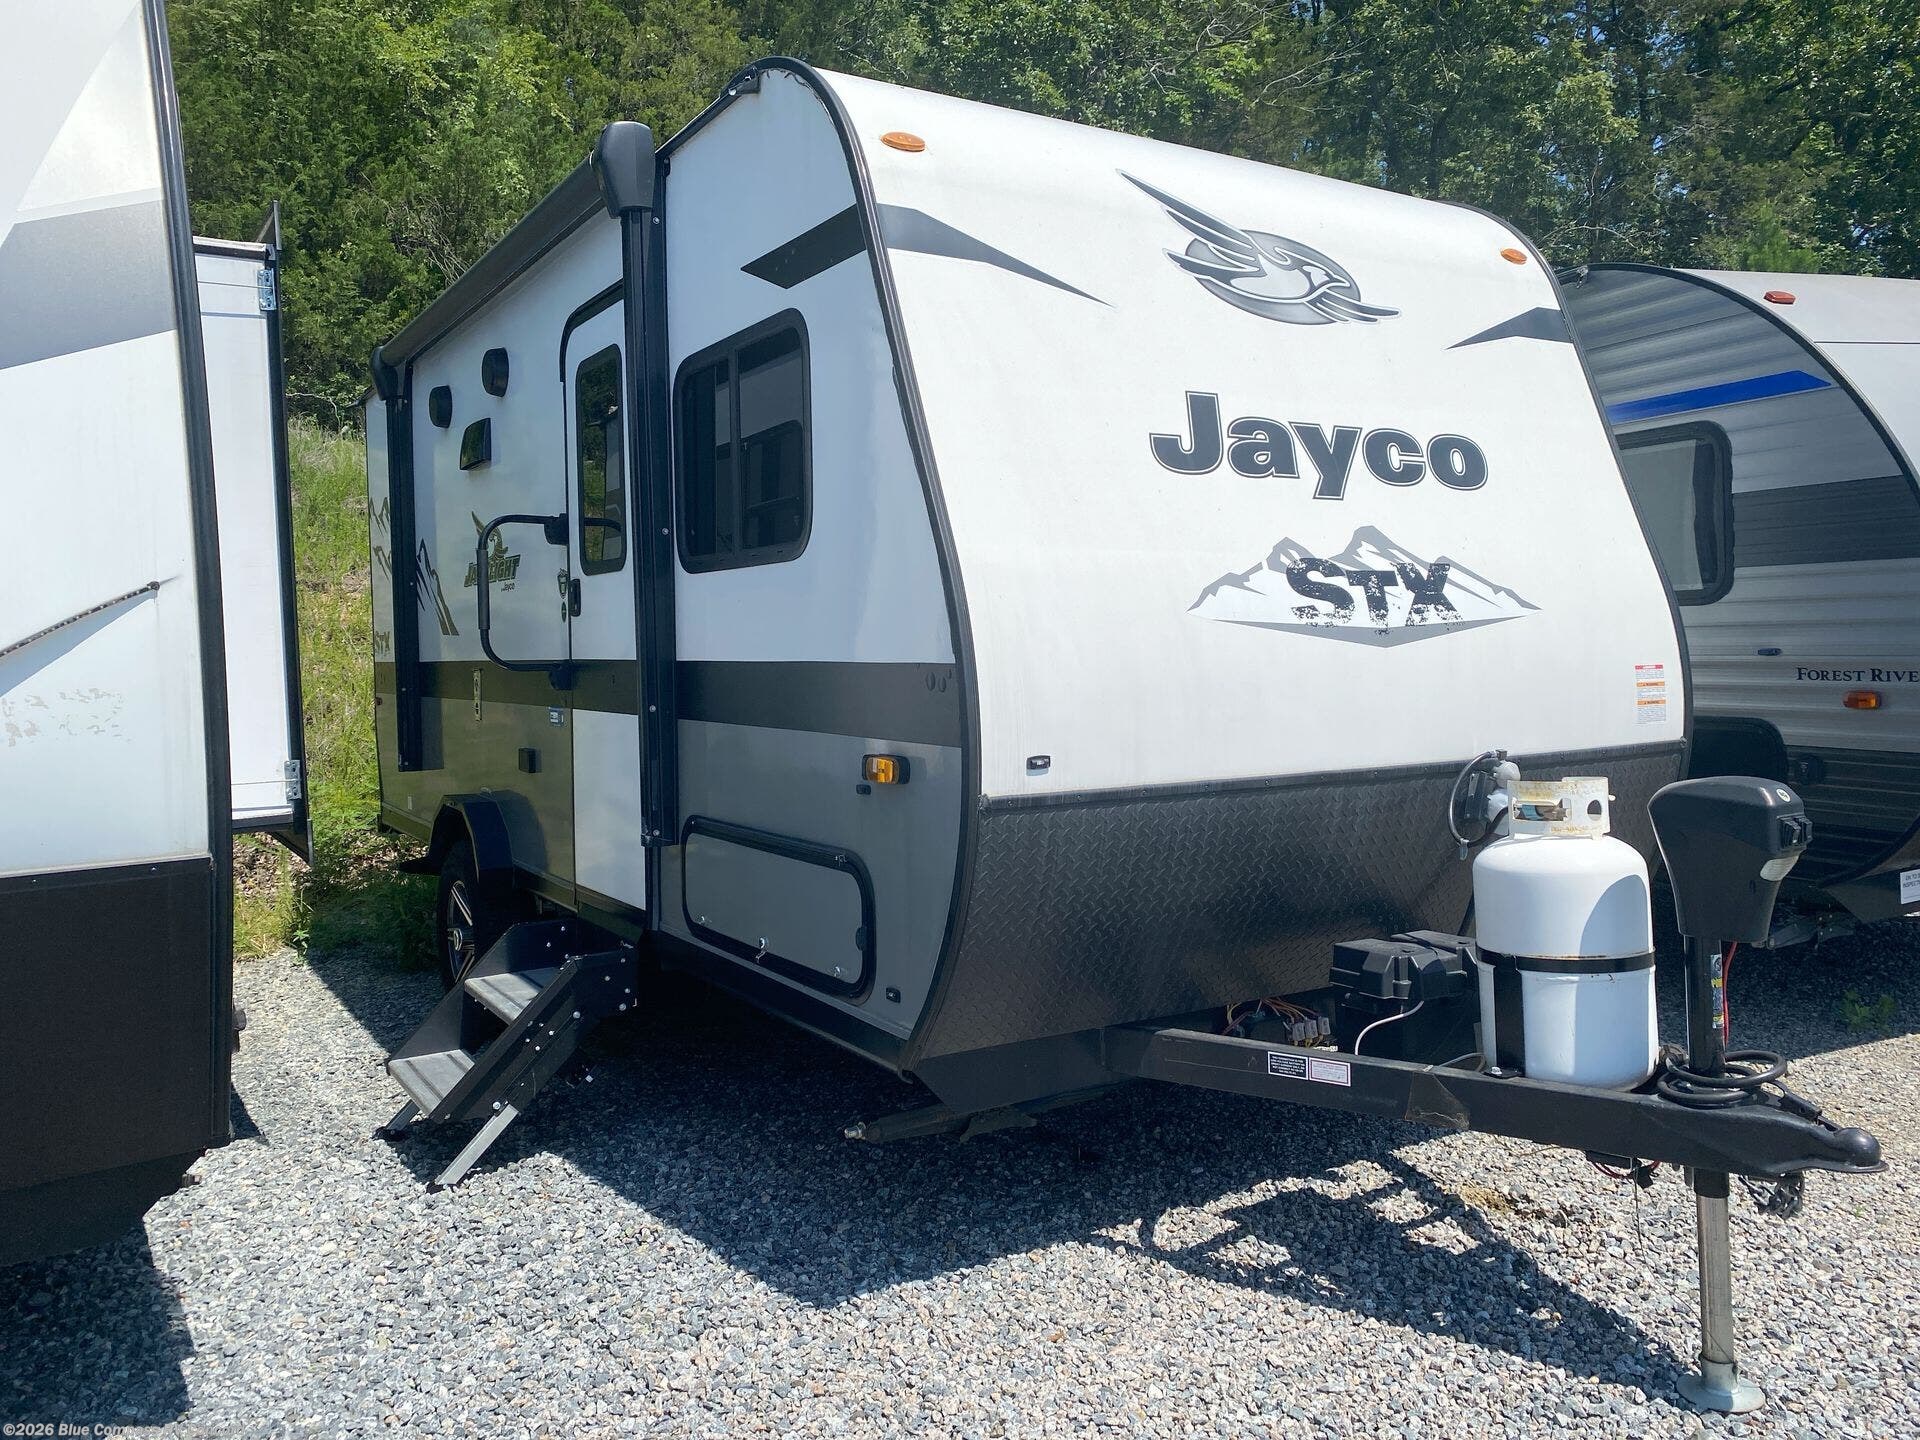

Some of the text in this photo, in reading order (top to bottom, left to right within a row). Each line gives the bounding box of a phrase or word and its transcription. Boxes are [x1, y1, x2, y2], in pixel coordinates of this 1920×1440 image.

[1149, 390, 1489, 500] Jayco
[1285, 557, 1465, 633] STX
[1796, 667, 1865, 682] FOREST
